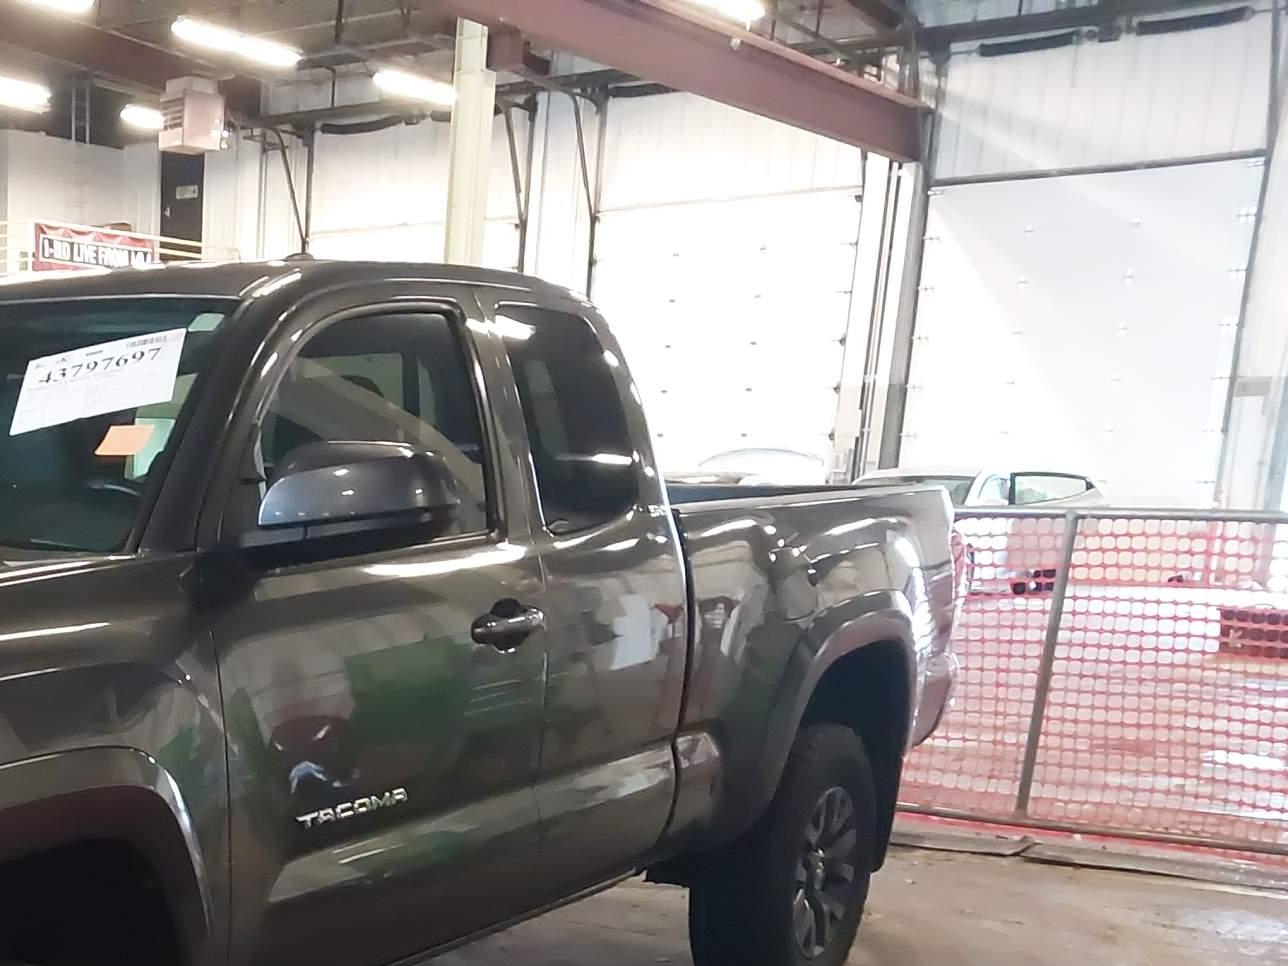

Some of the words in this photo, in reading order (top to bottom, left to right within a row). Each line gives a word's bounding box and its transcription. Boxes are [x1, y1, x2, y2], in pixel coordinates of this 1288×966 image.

[73, 241, 97, 265] LIVE
[98, 246, 129, 268] FROM
[38, 346, 162, 384] 43797697
[295, 787, 409, 829] TACOMA
